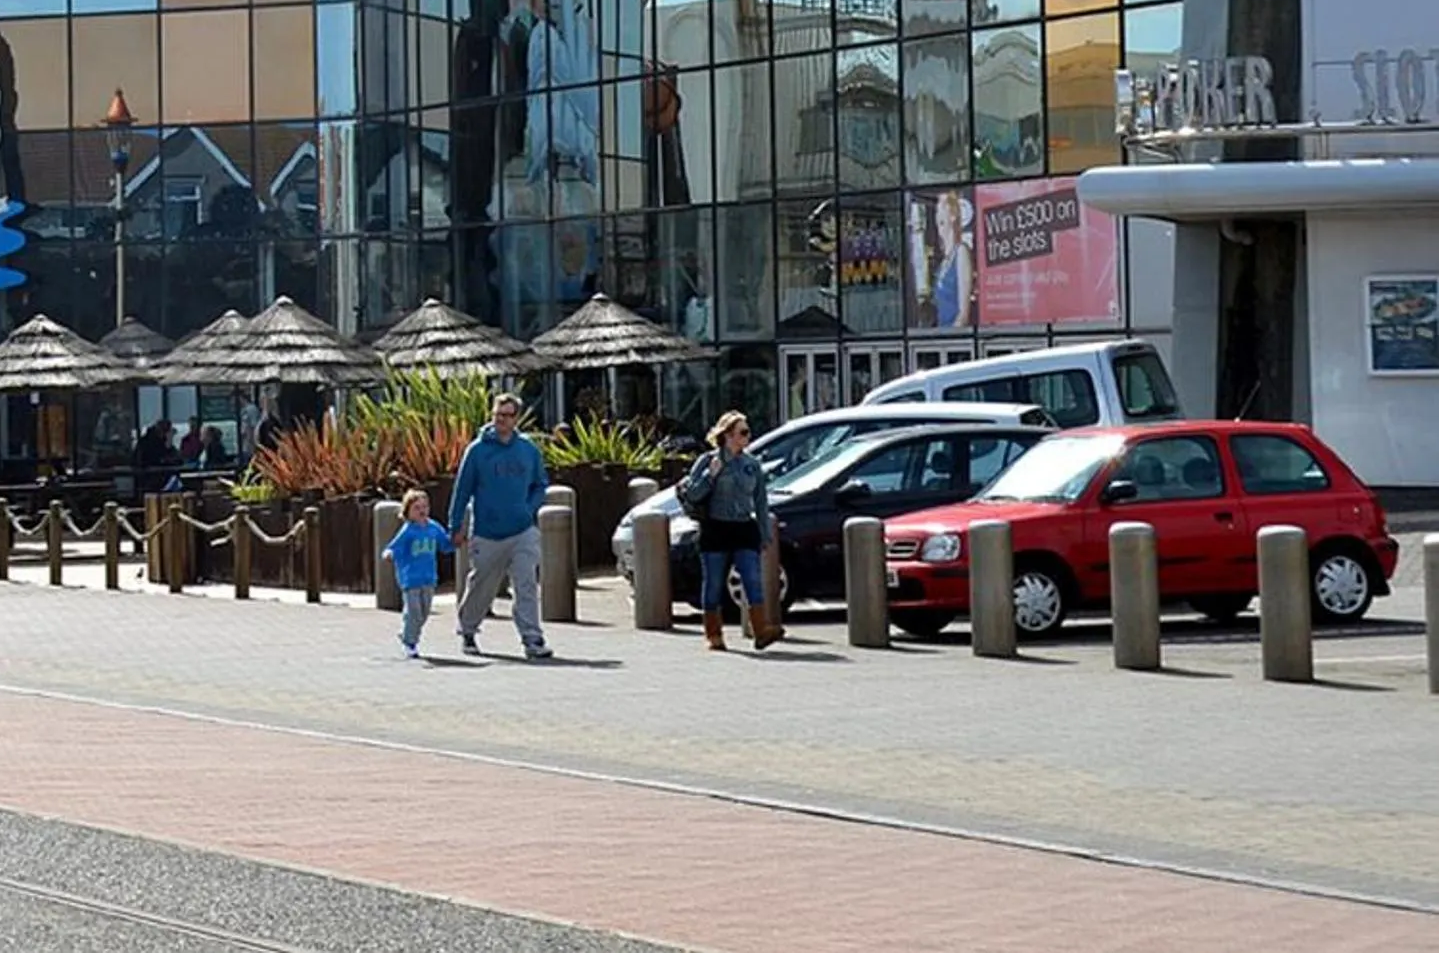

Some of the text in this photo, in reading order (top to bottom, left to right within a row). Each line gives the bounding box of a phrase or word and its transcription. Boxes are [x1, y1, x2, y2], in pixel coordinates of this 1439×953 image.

[1157, 55, 1277, 128] POKER
[1353, 49, 1439, 125] SLO
[986, 199, 1076, 235] Win £500 on
[987, 230, 1047, 261] the slots
